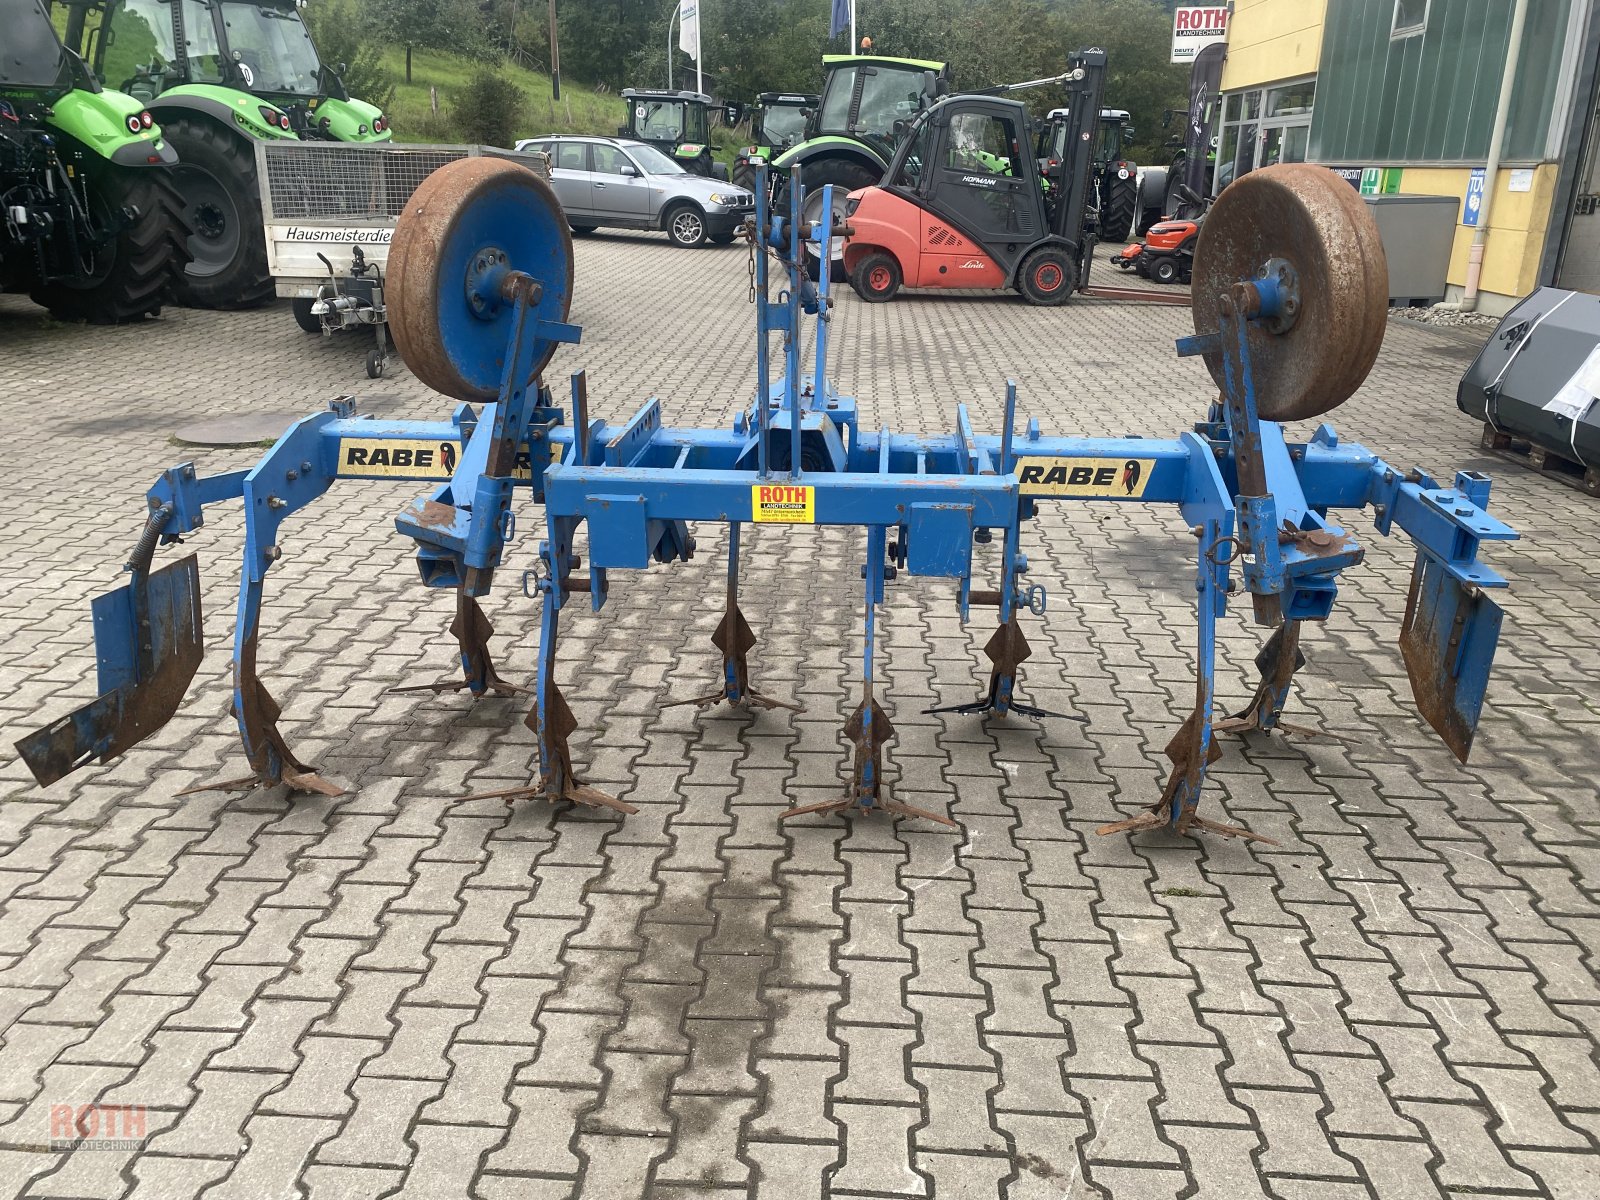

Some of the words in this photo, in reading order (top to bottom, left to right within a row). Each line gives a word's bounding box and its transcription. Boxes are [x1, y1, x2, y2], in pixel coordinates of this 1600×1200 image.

[1176, 9, 1227, 29] ROTH
[962, 175, 996, 186] HOFMANN
[286, 227, 393, 242] Hausmeisterdie
[959, 260, 985, 269] Linde
[347, 447, 434, 468] RABE
[1019, 465, 1118, 486] RABE
[760, 486, 807, 503] ROTH
